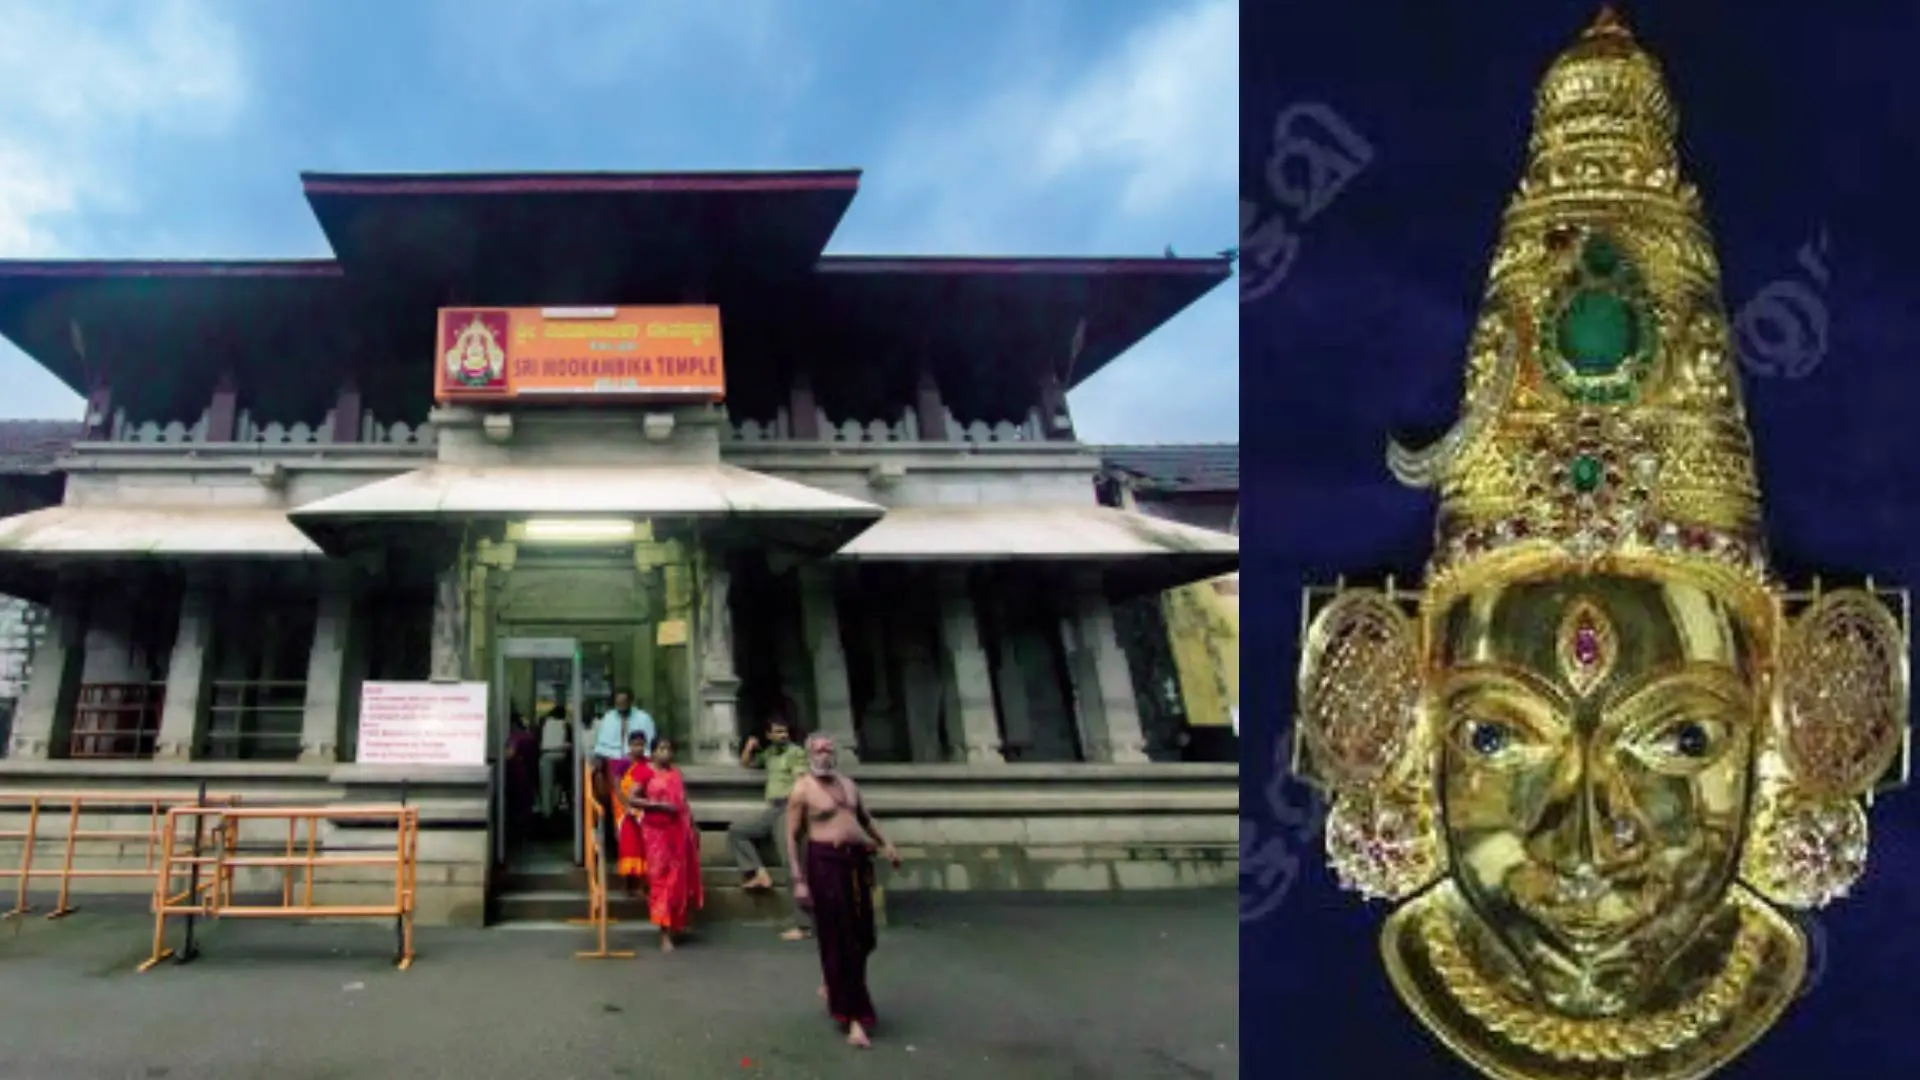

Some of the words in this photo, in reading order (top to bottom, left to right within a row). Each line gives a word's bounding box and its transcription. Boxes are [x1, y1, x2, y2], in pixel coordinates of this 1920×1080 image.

[514, 358, 536, 377] SRI
[541, 357, 653, 377] MOOKAMBIKA
[657, 355, 717, 376] TEMPLE
